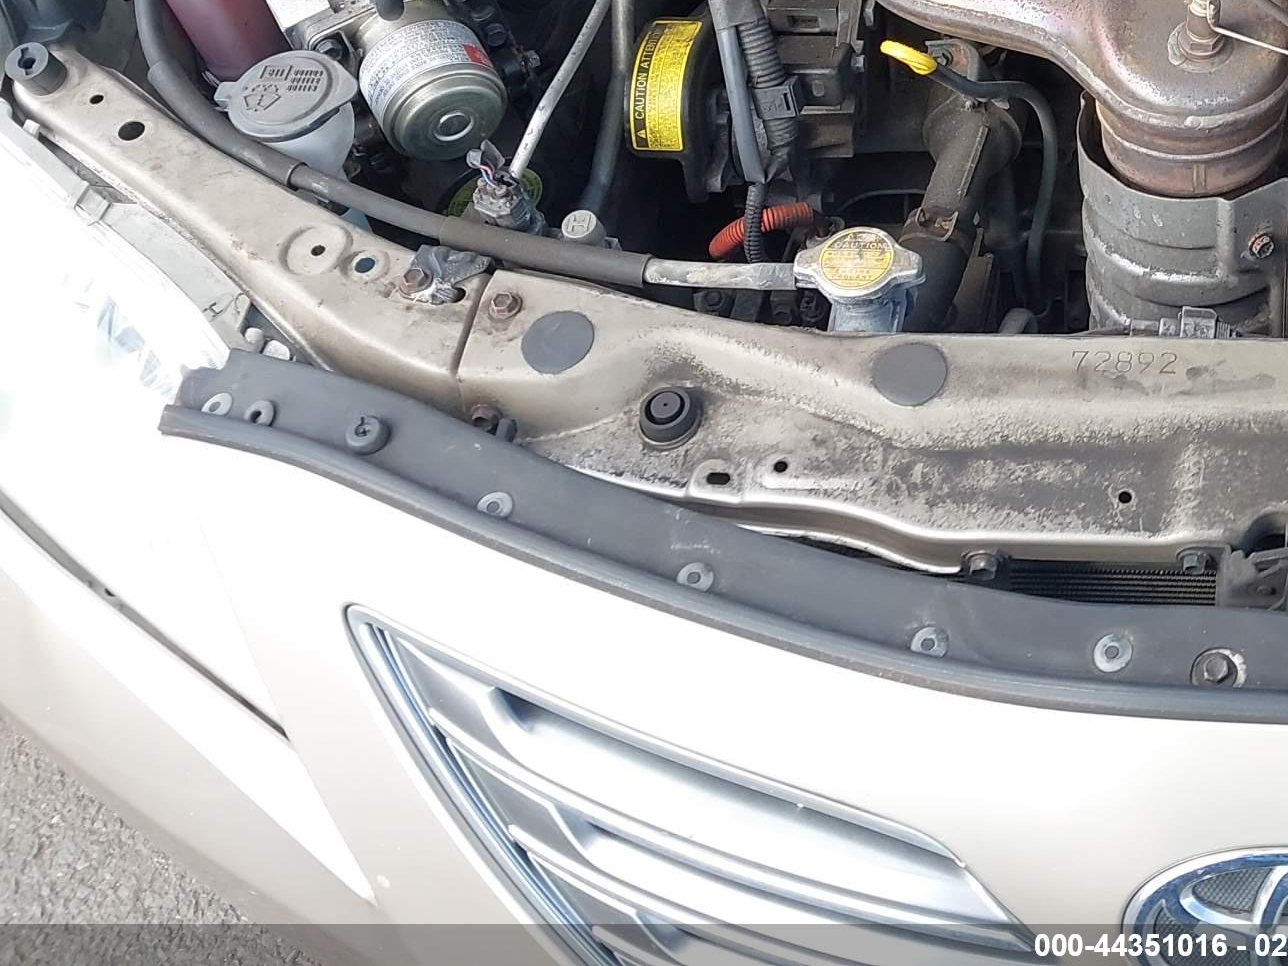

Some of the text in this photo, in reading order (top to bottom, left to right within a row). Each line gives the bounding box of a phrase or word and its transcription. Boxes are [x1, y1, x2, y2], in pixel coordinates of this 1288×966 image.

[634, 72, 648, 120] CAUTION
[834, 241, 885, 250] CAUTION
[1071, 350, 1178, 374] 72892
